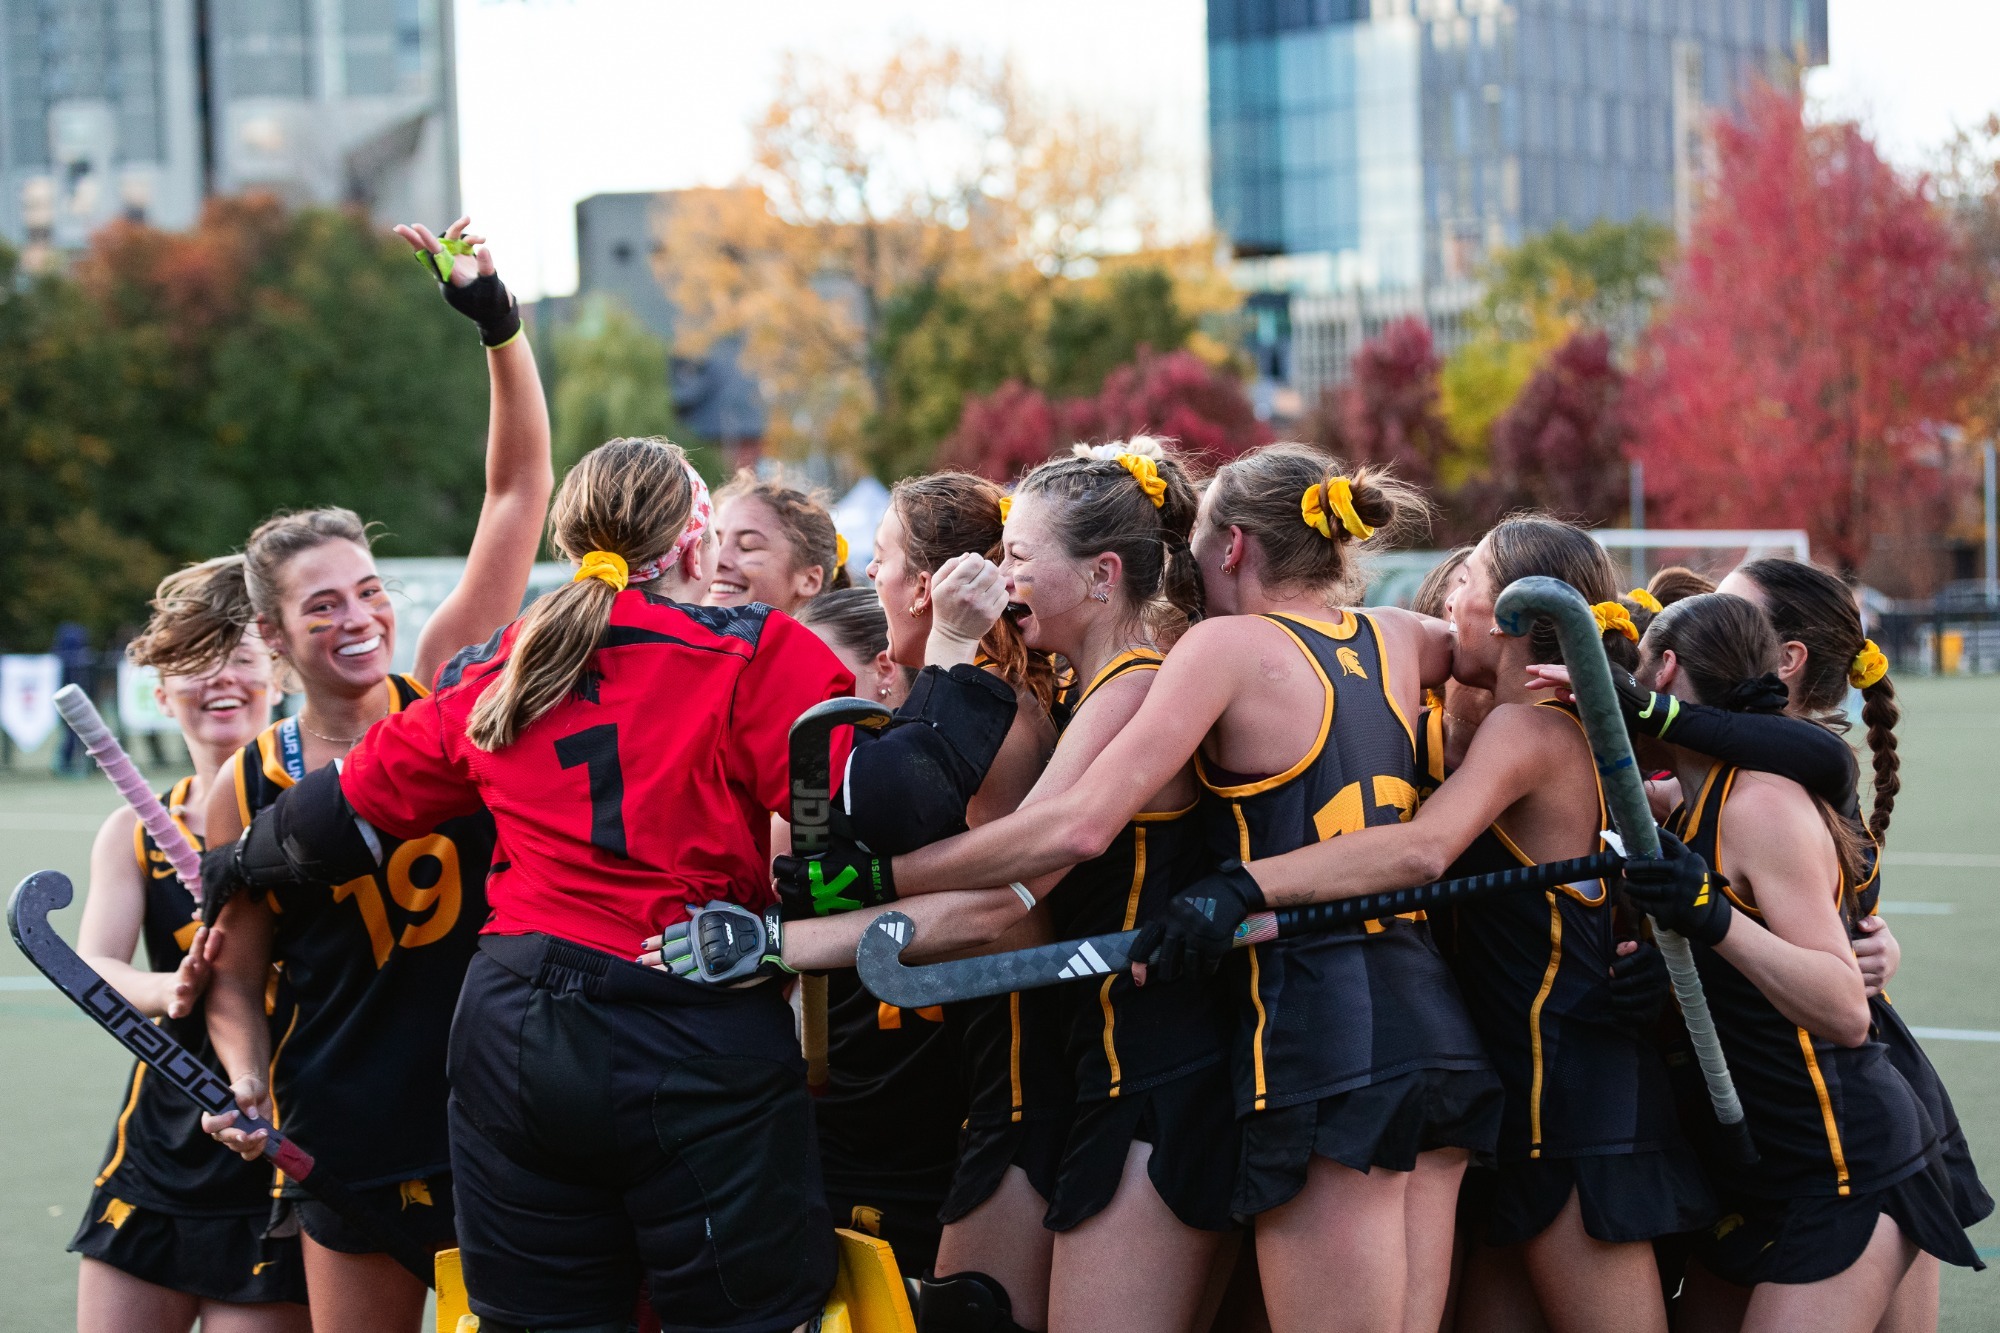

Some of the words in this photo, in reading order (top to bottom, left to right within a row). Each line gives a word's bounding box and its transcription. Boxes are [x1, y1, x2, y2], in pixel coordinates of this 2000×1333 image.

[554, 723, 629, 860] 1
[330, 833, 462, 970] 19
[872, 858, 883, 891] OSAKA
[82, 978, 235, 1113] brabo
